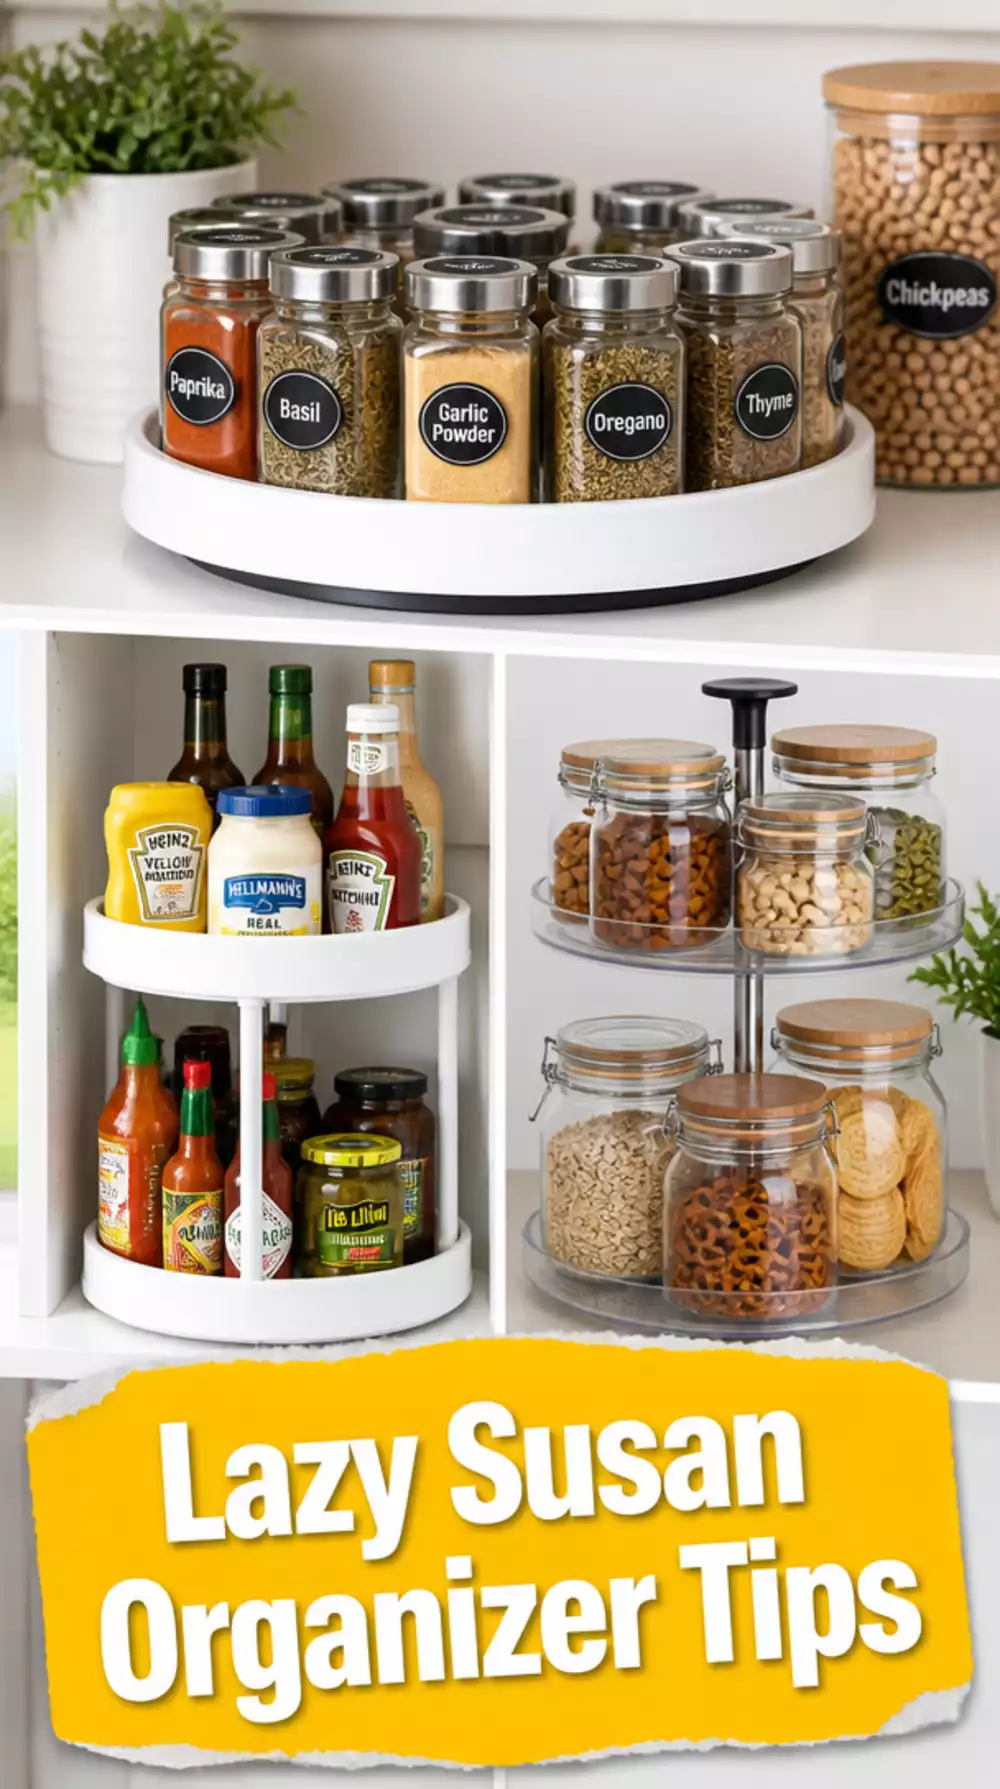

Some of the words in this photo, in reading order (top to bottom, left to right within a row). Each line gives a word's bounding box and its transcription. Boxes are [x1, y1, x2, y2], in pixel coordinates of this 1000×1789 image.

[886, 279, 989, 312] Chickpeas
[170, 371, 226, 401] Paprika
[280, 397, 321, 423] Basil
[438, 402, 489, 421] Garlic
[745, 392, 793, 418] Thyme
[432, 424, 496, 445] Powder
[594, 411, 666, 437] Oregano
